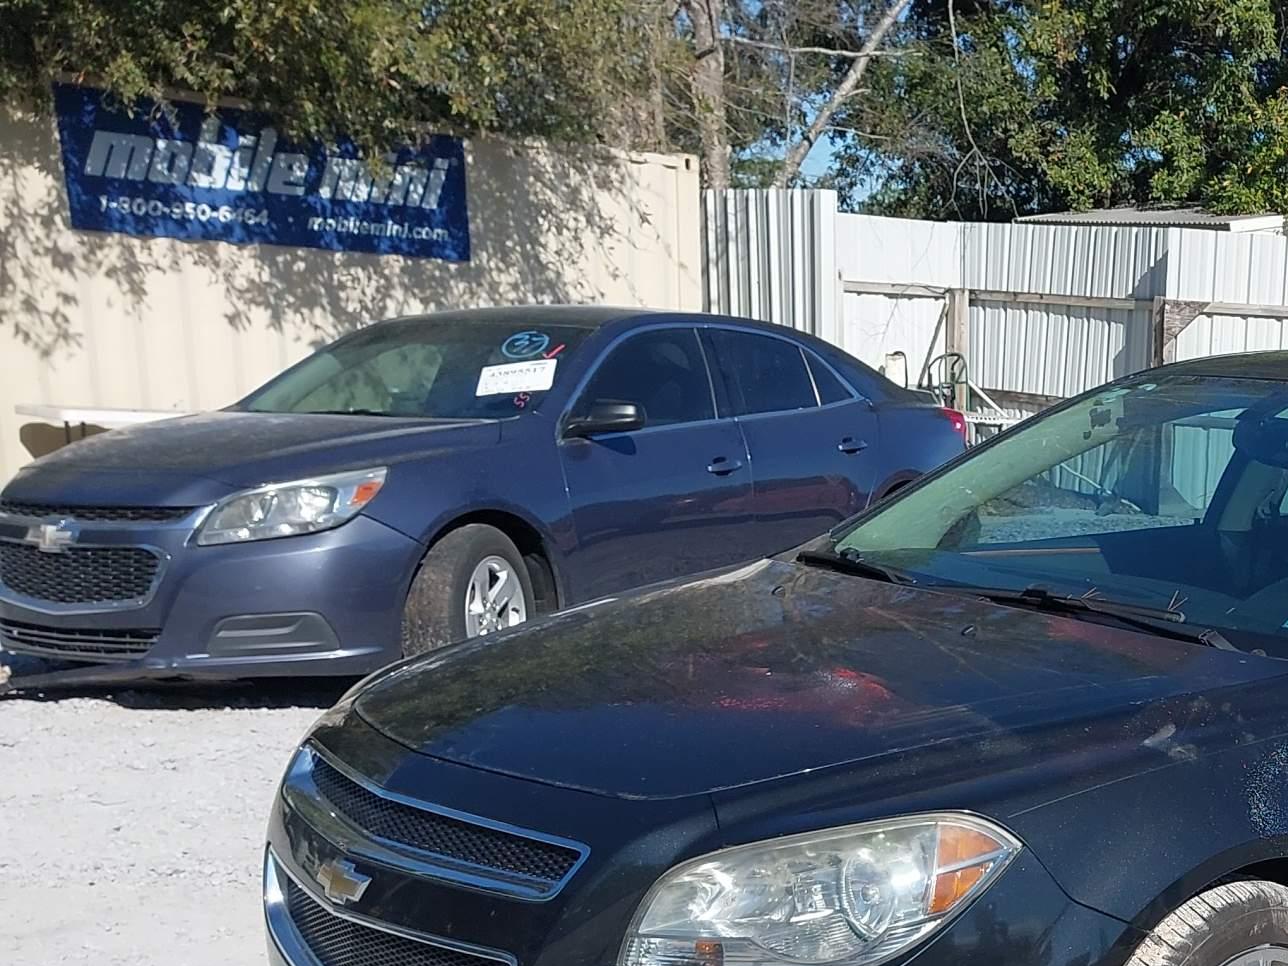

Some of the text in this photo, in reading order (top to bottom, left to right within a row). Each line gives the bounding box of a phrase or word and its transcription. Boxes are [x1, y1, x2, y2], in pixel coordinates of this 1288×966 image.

[84, 117, 310, 196] mobile
[99, 194, 449, 241] 1-800-950-6464 mobilemini.com
